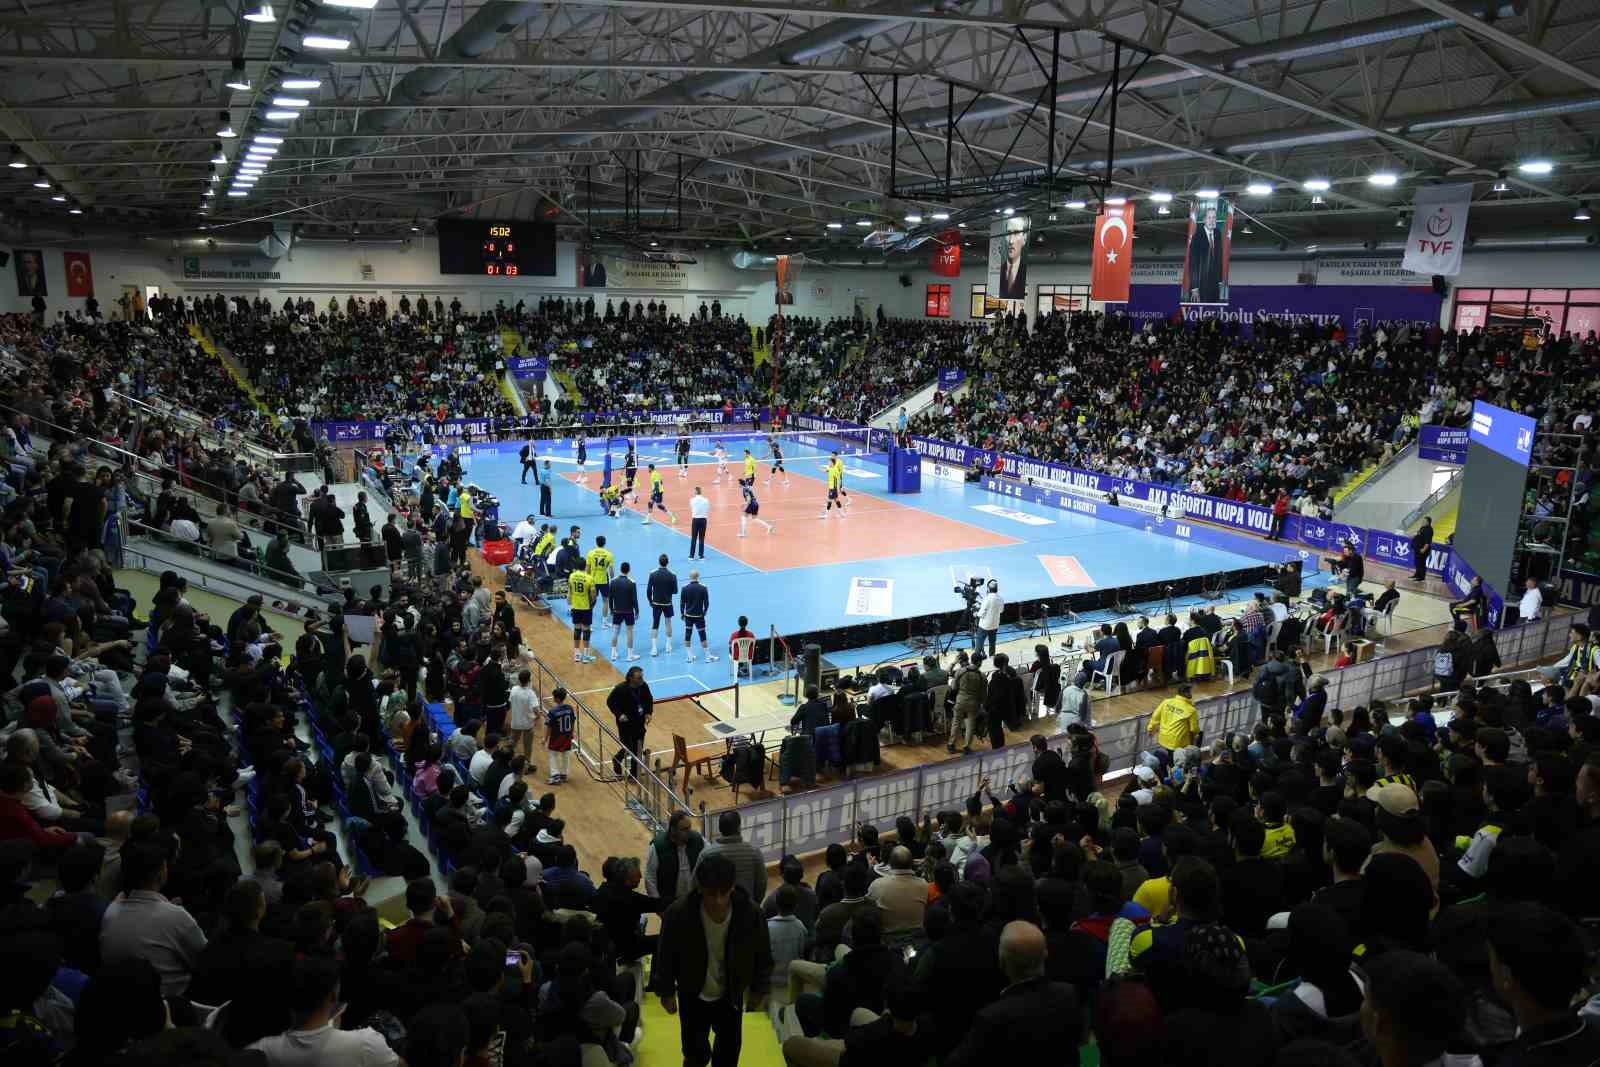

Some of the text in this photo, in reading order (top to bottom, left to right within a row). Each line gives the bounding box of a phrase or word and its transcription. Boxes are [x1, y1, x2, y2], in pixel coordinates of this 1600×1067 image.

[1418, 240, 1454, 256] TVF
[938, 255, 956, 265] TVF
[506, 265, 518, 275] 03
[458, 446, 471, 455] AXA
[928, 442, 945, 460] KUPA
[945, 446, 966, 464] VOLEY
[1018, 459, 1049, 481] SİGORTA
[1050, 467, 1072, 487] KUPA
[1073, 472, 1100, 491] VOLEY
[988, 480, 1023, 497] RİZE
[1060, 496, 1073, 509] AXA
[1148, 487, 1168, 507] AXA
[1169, 491, 1213, 518] SİGORTA
[1215, 501, 1245, 525] KUPA
[1176, 525, 1191, 538] AXA
[594, 557, 606, 568] 14
[573, 581, 584, 593] 18
[560, 715, 572, 732] 10
